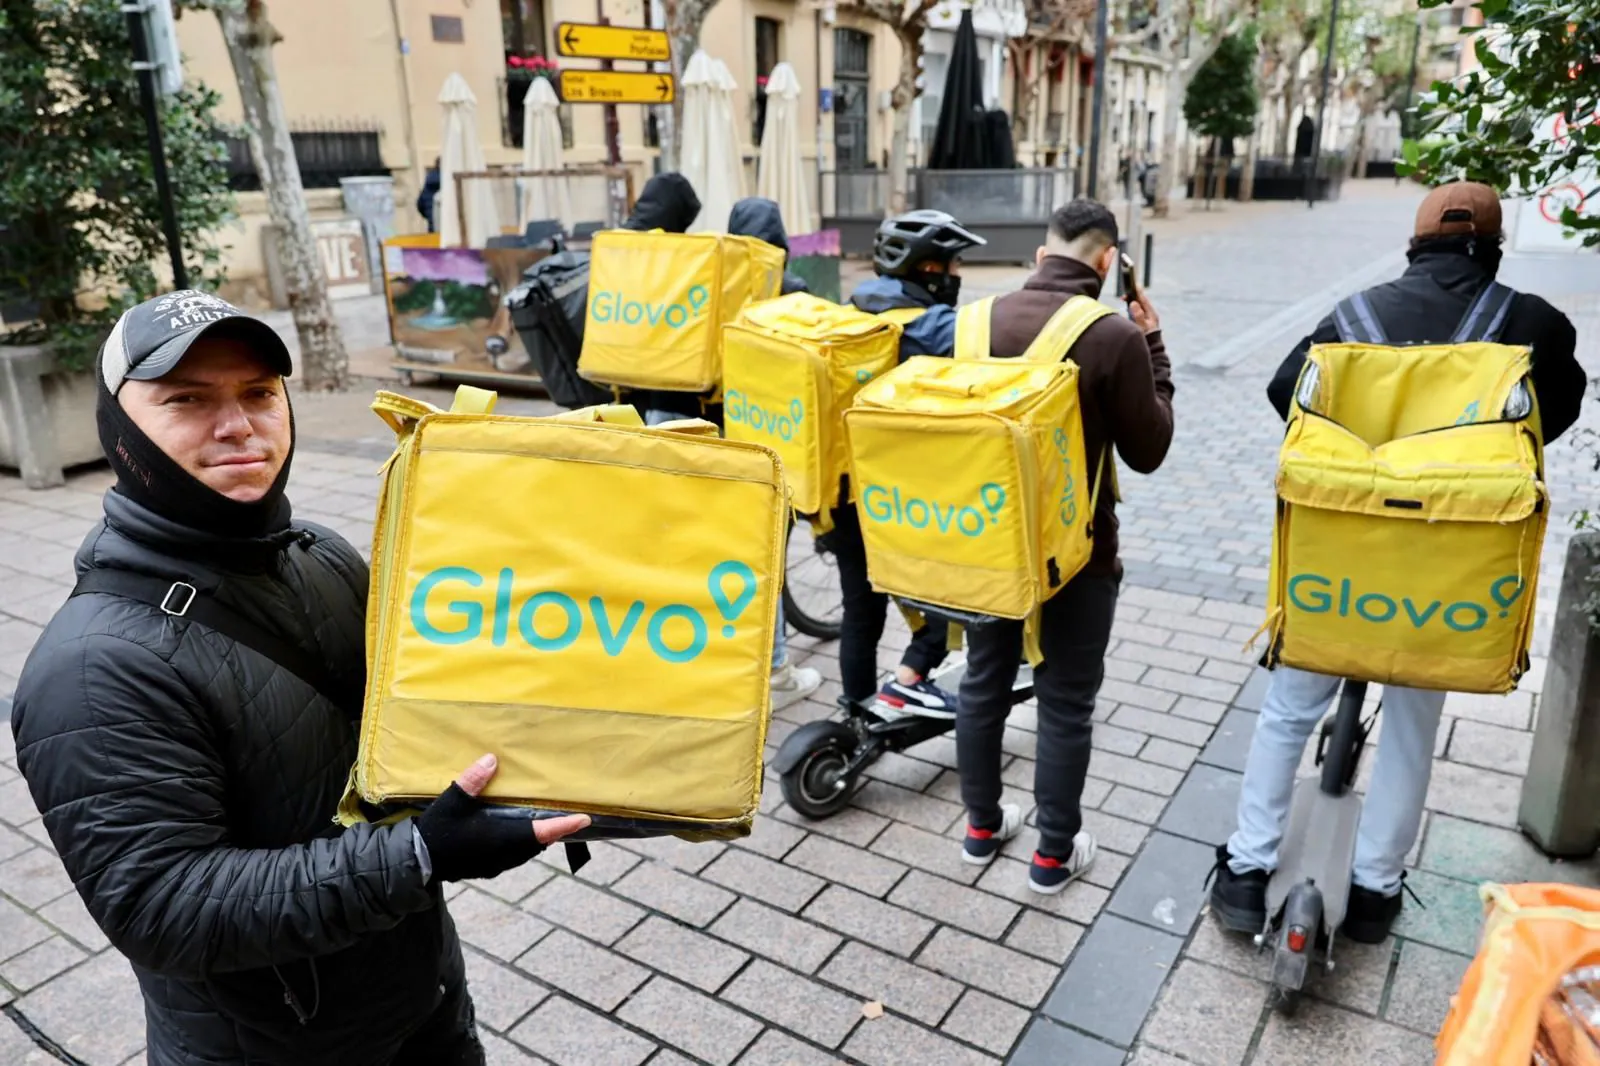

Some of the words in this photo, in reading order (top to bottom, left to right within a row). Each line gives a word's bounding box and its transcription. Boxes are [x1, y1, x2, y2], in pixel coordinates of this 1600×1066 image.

[591, 291, 688, 329] Glovo
[725, 389, 793, 442] Glovo
[863, 485, 985, 537] Glovo
[409, 566, 708, 664] Glovo
[1288, 574, 1488, 632] Glovo
